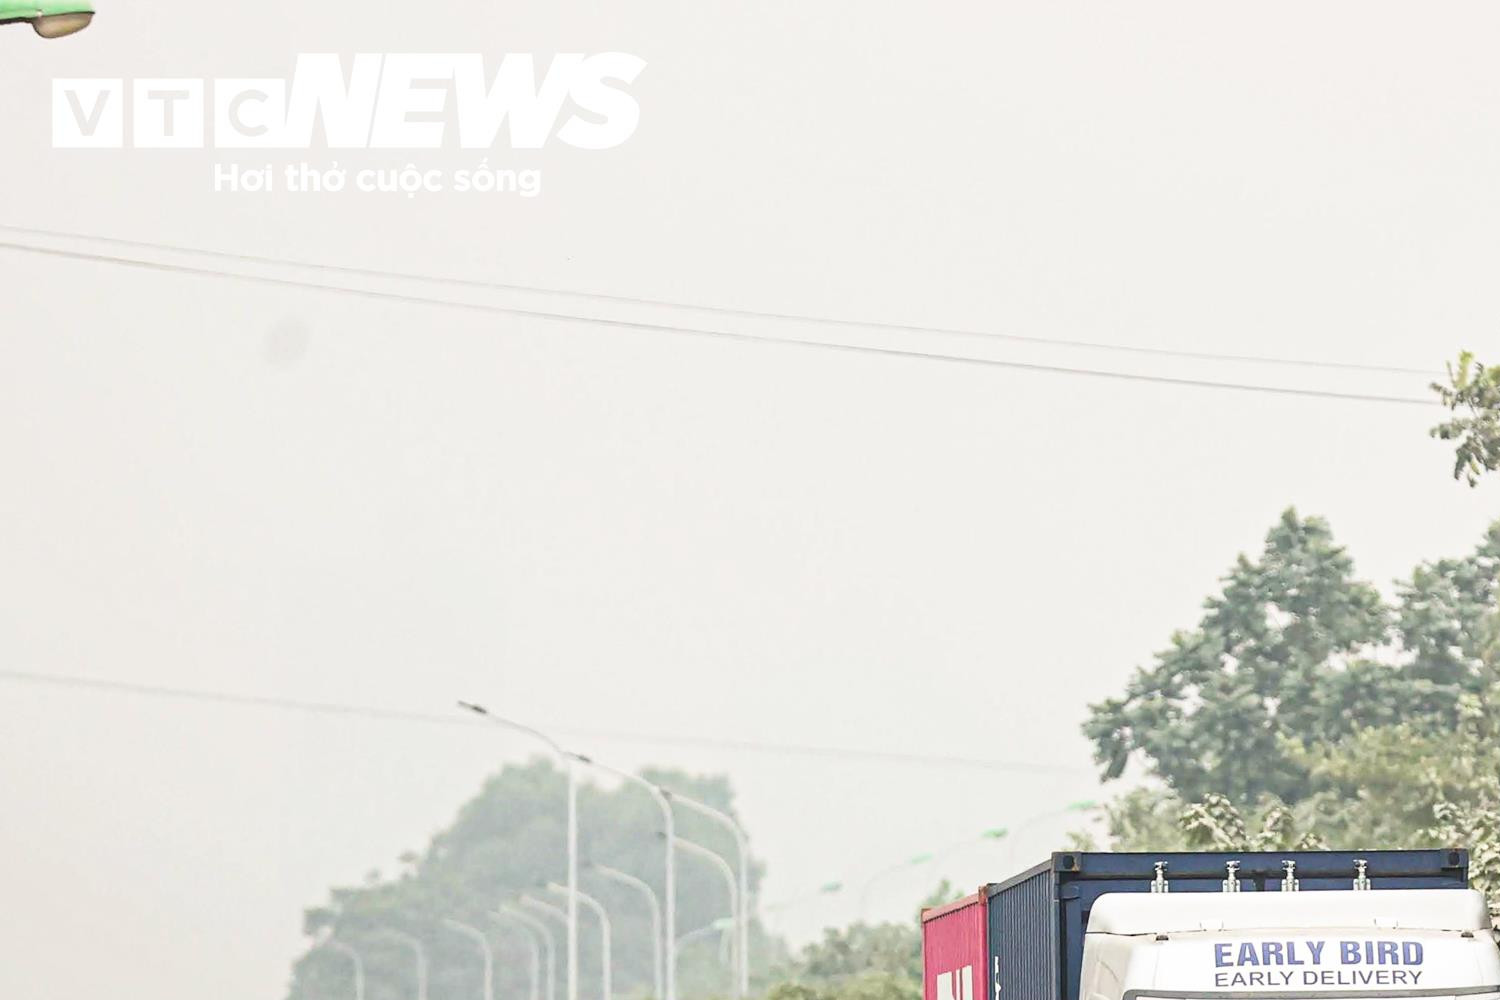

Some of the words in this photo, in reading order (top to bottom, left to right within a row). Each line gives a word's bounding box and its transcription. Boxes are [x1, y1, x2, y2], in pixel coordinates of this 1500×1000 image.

[1214, 941, 1326, 968] EARLY
[1339, 940, 1425, 966] BIRD
[1214, 970, 1295, 987] EARLY
[1302, 969, 1423, 986] DELIVERY
